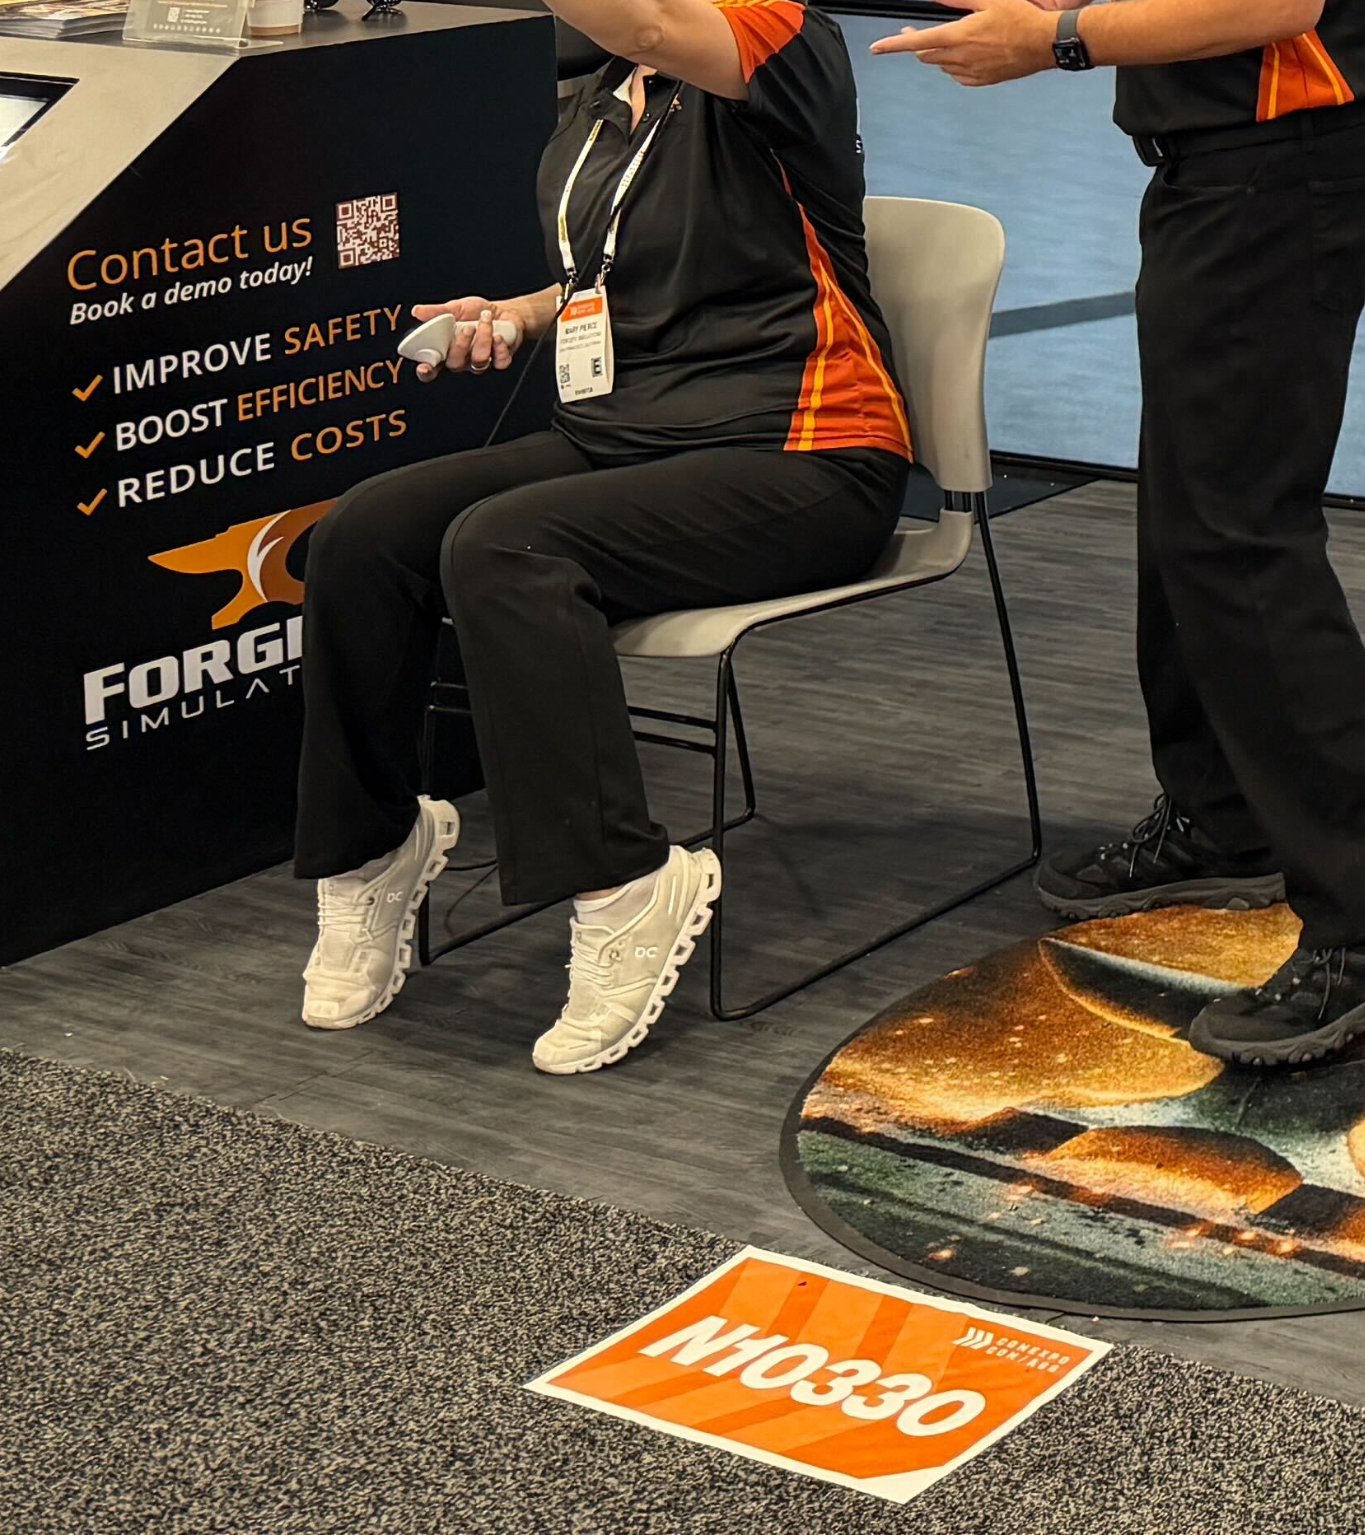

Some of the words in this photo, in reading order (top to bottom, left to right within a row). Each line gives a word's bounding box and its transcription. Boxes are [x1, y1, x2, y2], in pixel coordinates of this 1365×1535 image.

[67, 224, 249, 291] Contact
[264, 217, 312, 253] us
[69, 292, 134, 325] Book
[141, 290, 157, 310] a
[164, 276, 232, 305] demo
[239, 256, 314, 289] today!
[113, 332, 272, 394] IMPROVE
[284, 304, 402, 355] SAFETY
[115, 398, 228, 452] BOOST
[237, 357, 404, 421] EFFICIENCY
[117, 442, 275, 508] REDUCE
[291, 409, 408, 461] COSTS
[638, 1315, 986, 1437] N10330
[996, 1337, 1071, 1365] CONEXPO
